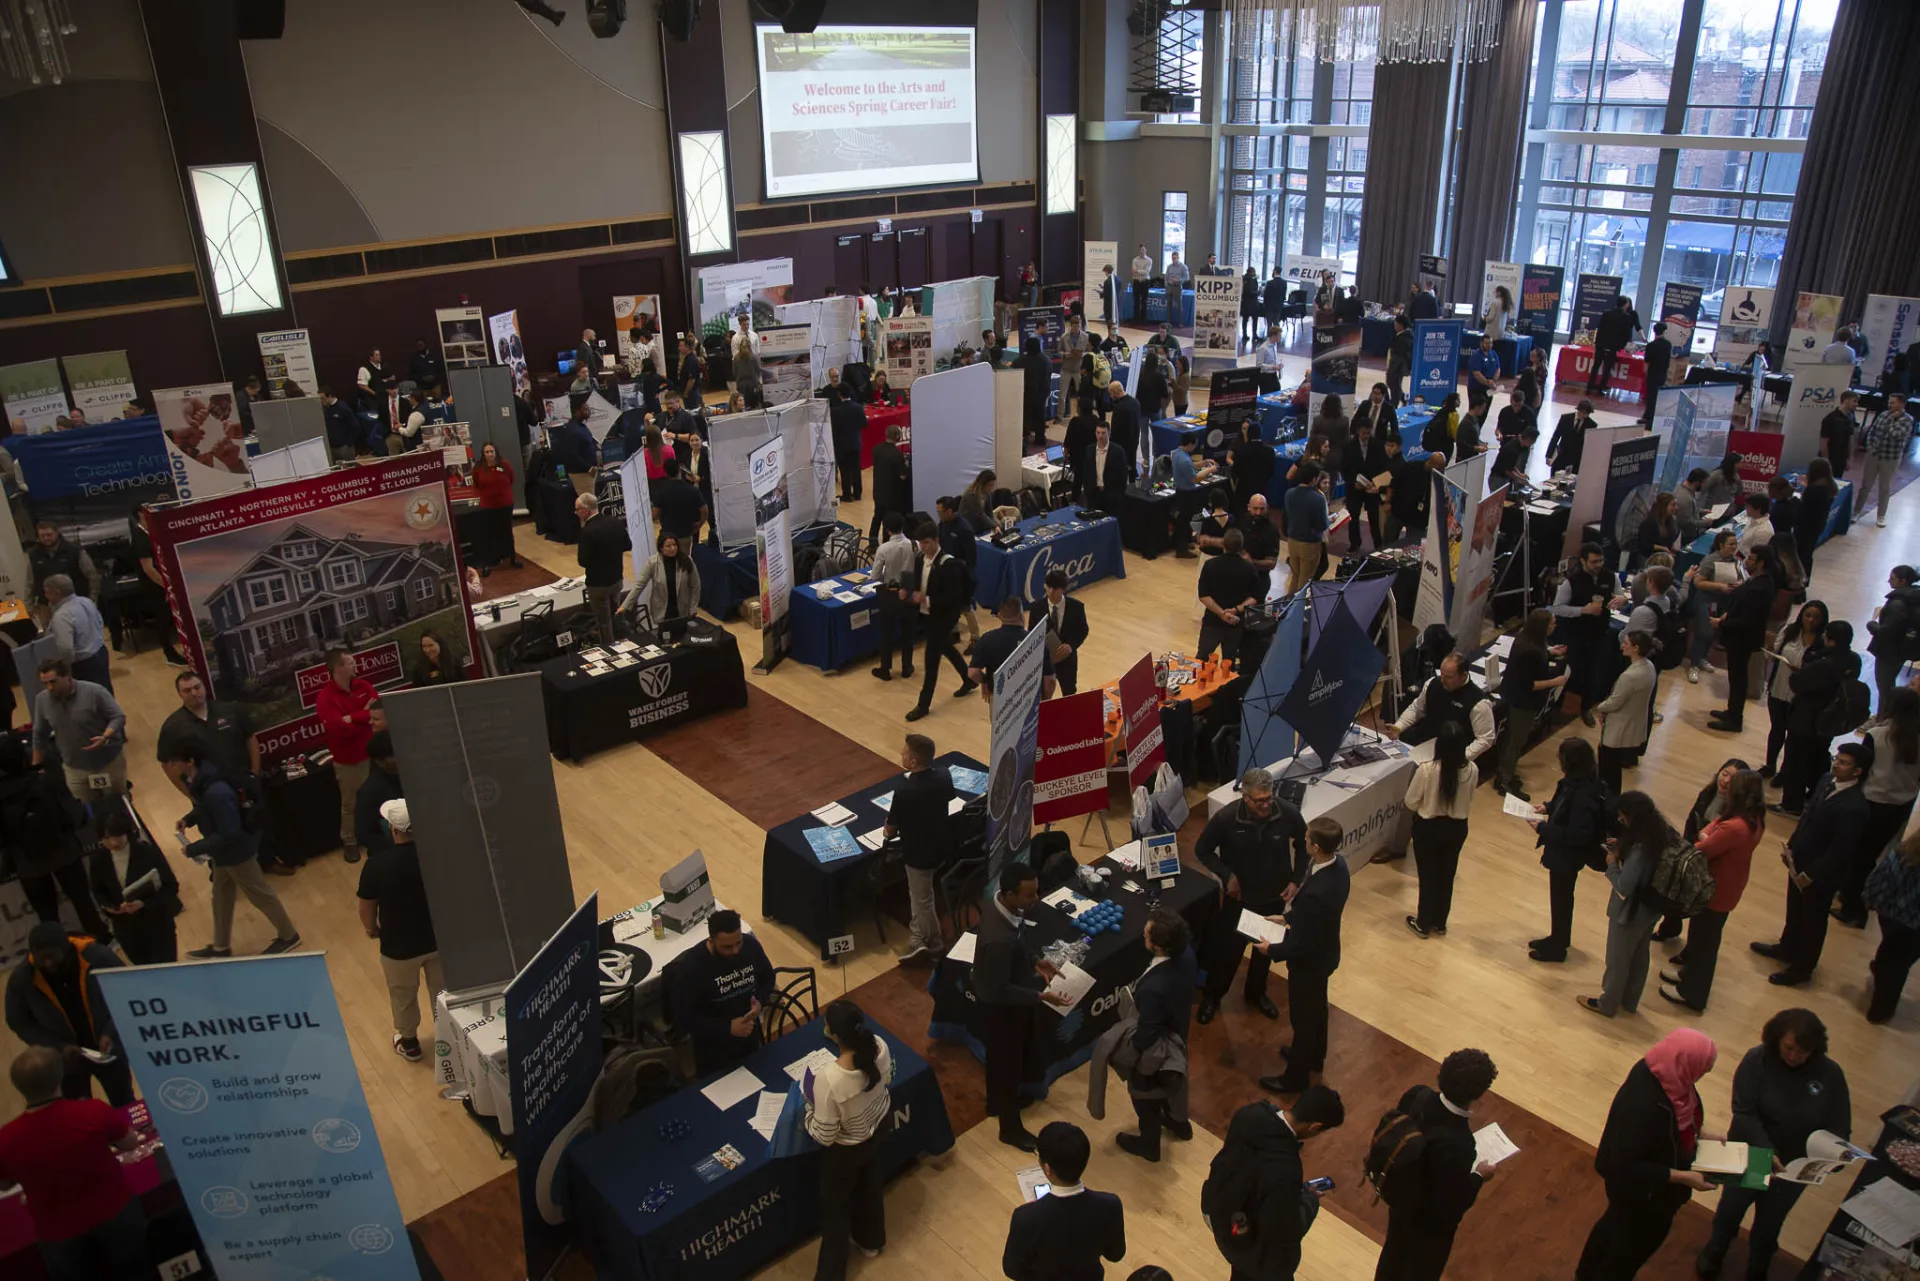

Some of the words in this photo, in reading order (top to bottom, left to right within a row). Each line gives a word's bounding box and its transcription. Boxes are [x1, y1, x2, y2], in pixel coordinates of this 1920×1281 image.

[804, 82, 860, 97] Welcome
[864, 83, 875, 95] to
[877, 82, 897, 95] the
[899, 81, 922, 95] Arts
[925, 80, 946, 93] and
[792, 102, 846, 116] Sciences
[848, 100, 888, 116] Spring
[890, 98, 928, 112] Career
[930, 97, 957, 109] Fair!
[1197, 281, 1233, 294] KIPP
[98, 392, 133, 402] CLIFFS
[1800, 388, 1835, 402] PSA
[31, 402, 64, 414] CLIFFS
[74, 461, 133, 481] Create
[171, 452, 190, 486] JOIN
[78, 470, 174, 497] Technology
[168, 511, 225, 530] CINCINNATI
[239, 494, 292, 512] NORTHERN
[295, 491, 308, 503] KY
[321, 476, 370, 494] COLUMBUS
[382, 460, 442, 481] INDIANAPOLIS
[200, 516, 246, 533] ATLANTA
[260, 500, 316, 518] LOUISVILLE
[330, 487, 367, 503] DAYTON
[379, 482, 393, 491] ST.
[394, 474, 421, 488] LOUIS
[559, 635, 569, 645] 85
[354, 651, 398, 674] HOMES
[1007, 646, 1031, 681] Oakwood
[1308, 679, 1343, 700] amplifybio
[628, 701, 655, 717] WAKE
[656, 692, 689, 708] FOREST
[630, 700, 690, 729] BUSINESS
[1047, 740, 1085, 756] Oakwood
[1128, 740, 1148, 764] BUCKEYE
[93, 776, 107, 788] 83
[1034, 776, 1076, 793] BUCKEYE
[1078, 770, 1105, 783] LEVEL
[1048, 782, 1092, 799] SPONSOR
[833, 939, 850, 953] 52
[526, 947, 581, 1019] HIGHMARK
[714, 970, 740, 986] Thank
[740, 964, 754, 979] you
[720, 984, 731, 994] for
[732, 975, 755, 988] being
[539, 974, 571, 1019] HEALTH
[128, 998, 168, 1017] DO
[138, 1011, 320, 1042] MEANINGFUL
[521, 1001, 578, 1073] Transform
[147, 1044, 241, 1067] WORK.
[523, 1064, 542, 1092] the
[545, 1020, 578, 1065] future
[580, 998, 592, 1020] of
[212, 1076, 251, 1089] Build
[254, 1074, 281, 1086] and
[284, 1071, 322, 1085] grow
[525, 1031, 583, 1110] healthcare
[216, 1086, 309, 1103] relationships
[526, 1091, 551, 1126] with
[552, 1071, 569, 1092] us.
[181, 1134, 231, 1148] Create
[234, 1127, 308, 1141] innovative
[187, 1146, 251, 1160] solutions
[250, 1177, 314, 1192] Leverage
[318, 1176, 327, 1185] a
[329, 1170, 374, 1187] global
[254, 1187, 331, 1205] technology
[259, 1201, 319, 1216] platform
[681, 1186, 781, 1261] HIGHMARK
[224, 1240, 241, 1250] Be
[258, 1234, 302, 1249] supply
[305, 1231, 341, 1244] chain
[705, 1215, 763, 1260] HEALTH
[228, 1249, 273, 1263] expert
